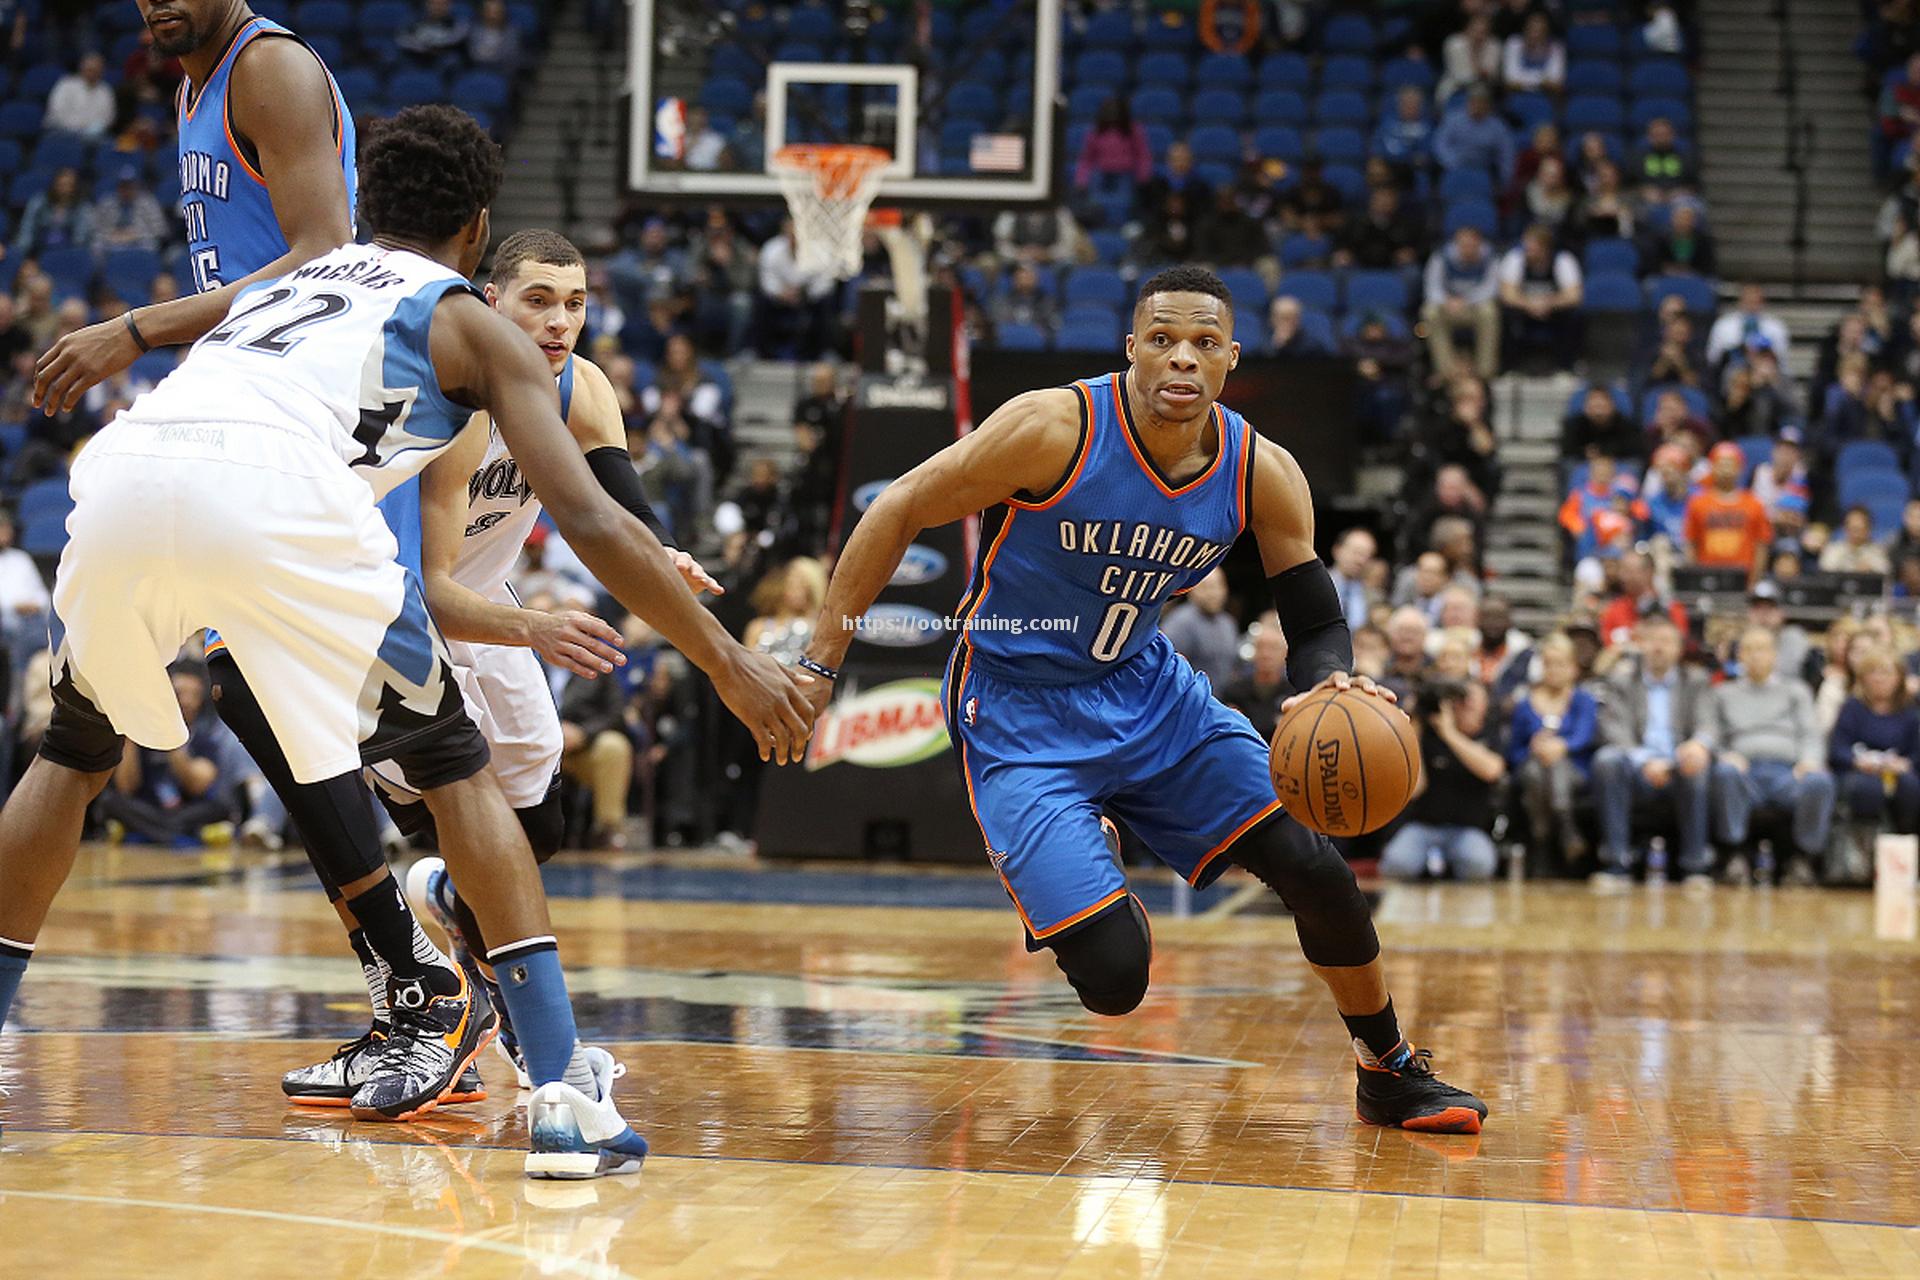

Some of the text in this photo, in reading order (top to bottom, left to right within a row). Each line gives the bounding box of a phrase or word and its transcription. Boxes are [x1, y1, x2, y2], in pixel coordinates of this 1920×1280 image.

[292, 261, 405, 290] WIGGINS
[200, 286, 354, 357] 22
[1100, 565, 1174, 601] CITY
[1091, 602, 1139, 662] 0
[1316, 739, 1350, 830] SPALDING
